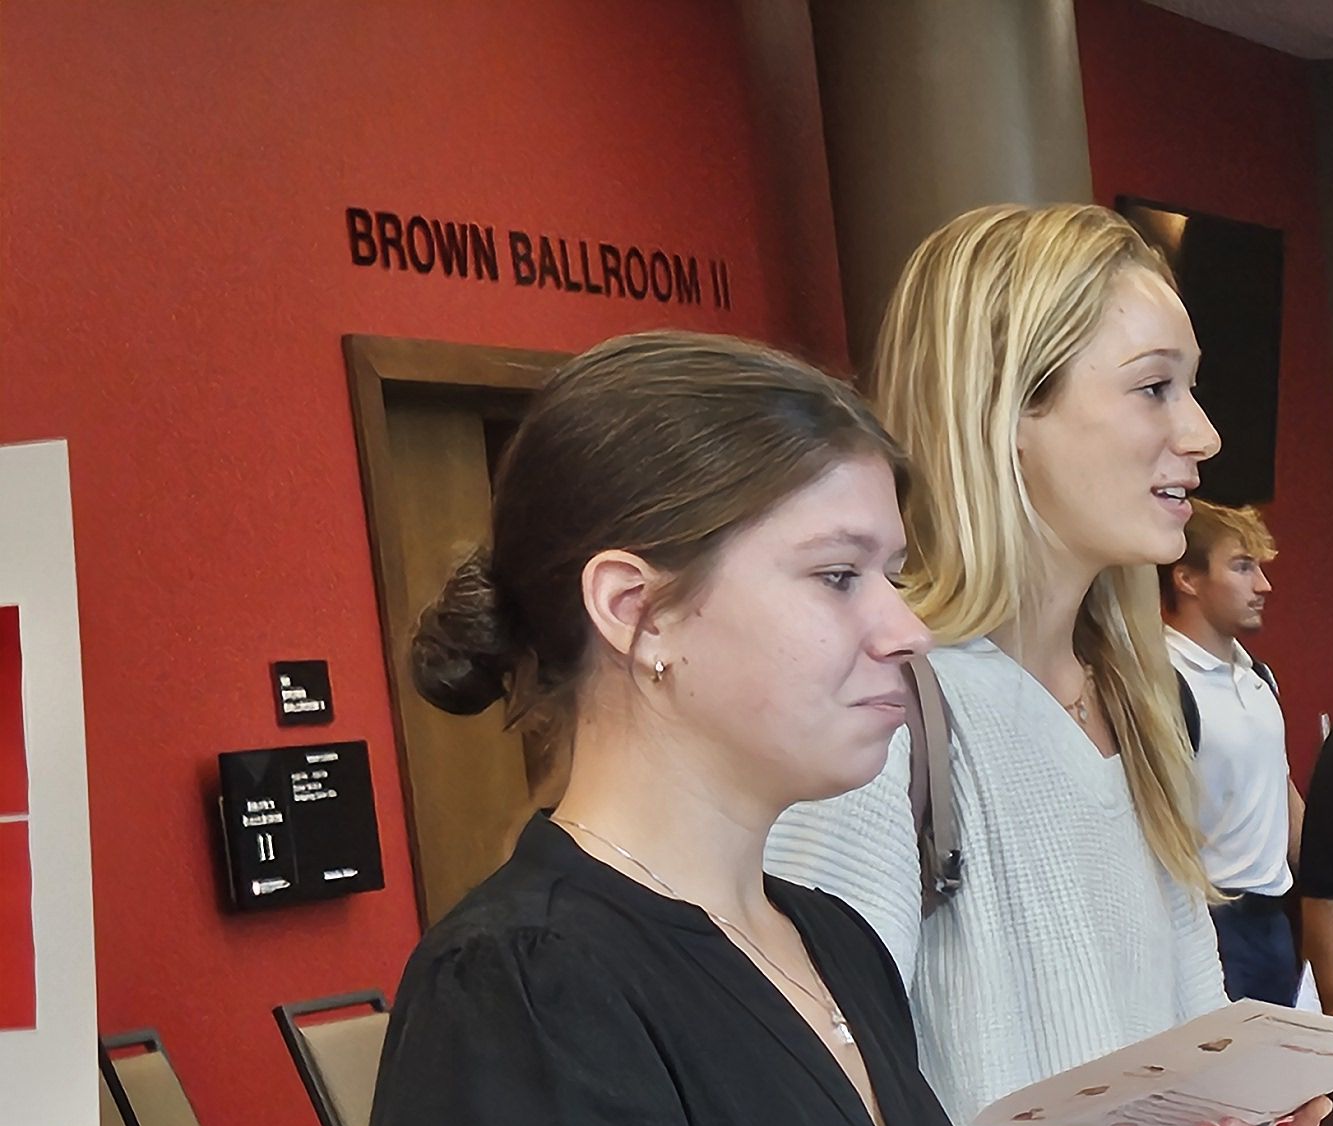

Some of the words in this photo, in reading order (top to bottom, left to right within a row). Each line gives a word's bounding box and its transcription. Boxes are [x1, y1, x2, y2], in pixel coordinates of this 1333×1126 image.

[346, 206, 499, 282] BROWN
[508, 230, 701, 306] BALLROOM
[709, 259, 732, 313] II
